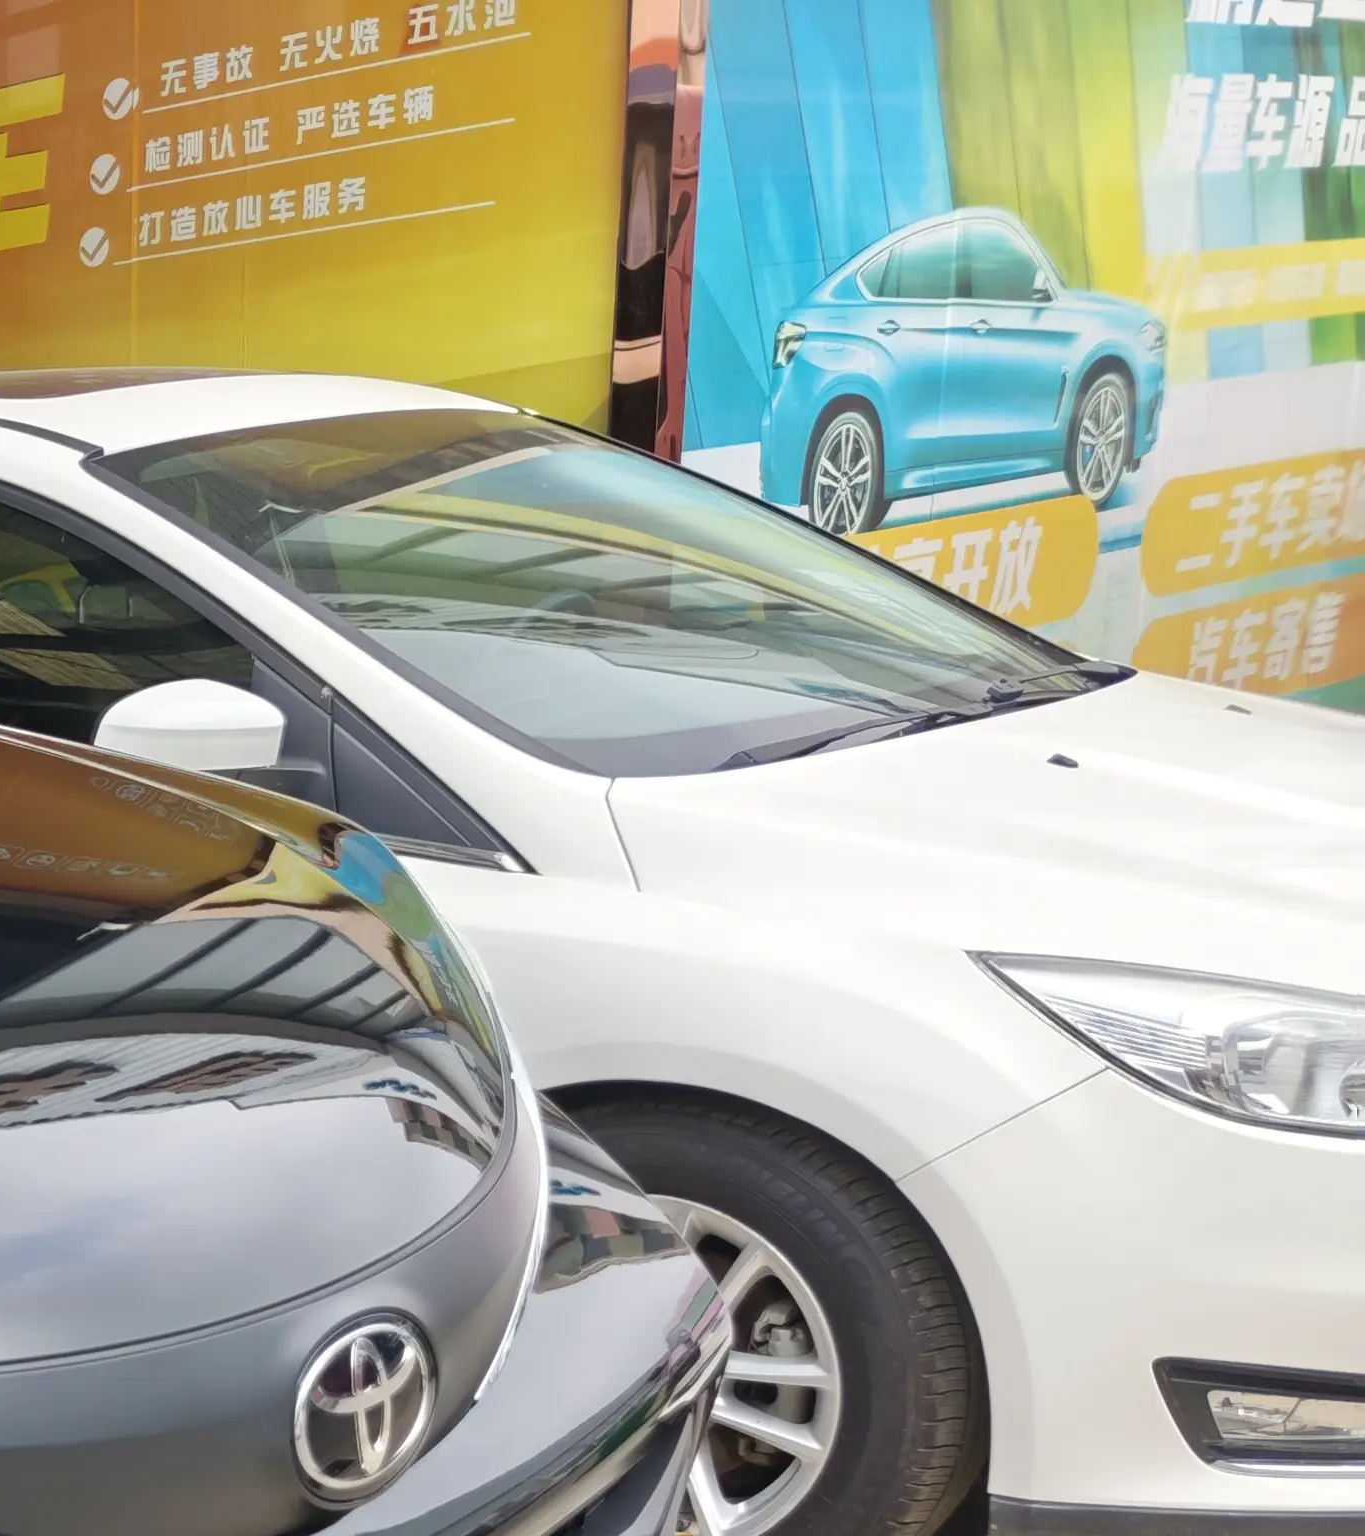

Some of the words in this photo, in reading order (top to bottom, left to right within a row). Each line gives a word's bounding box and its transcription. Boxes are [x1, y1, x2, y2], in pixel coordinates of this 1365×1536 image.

[160, 46, 254, 98] 无事故
[280, 17, 380, 72] 无火烧
[145, 116, 270, 173] 检测认证
[297, 85, 434, 145] 严选车辆
[139, 177, 366, 247] 打造放心车服务
[1187, 591, 1346, 690] 汽车寄售
